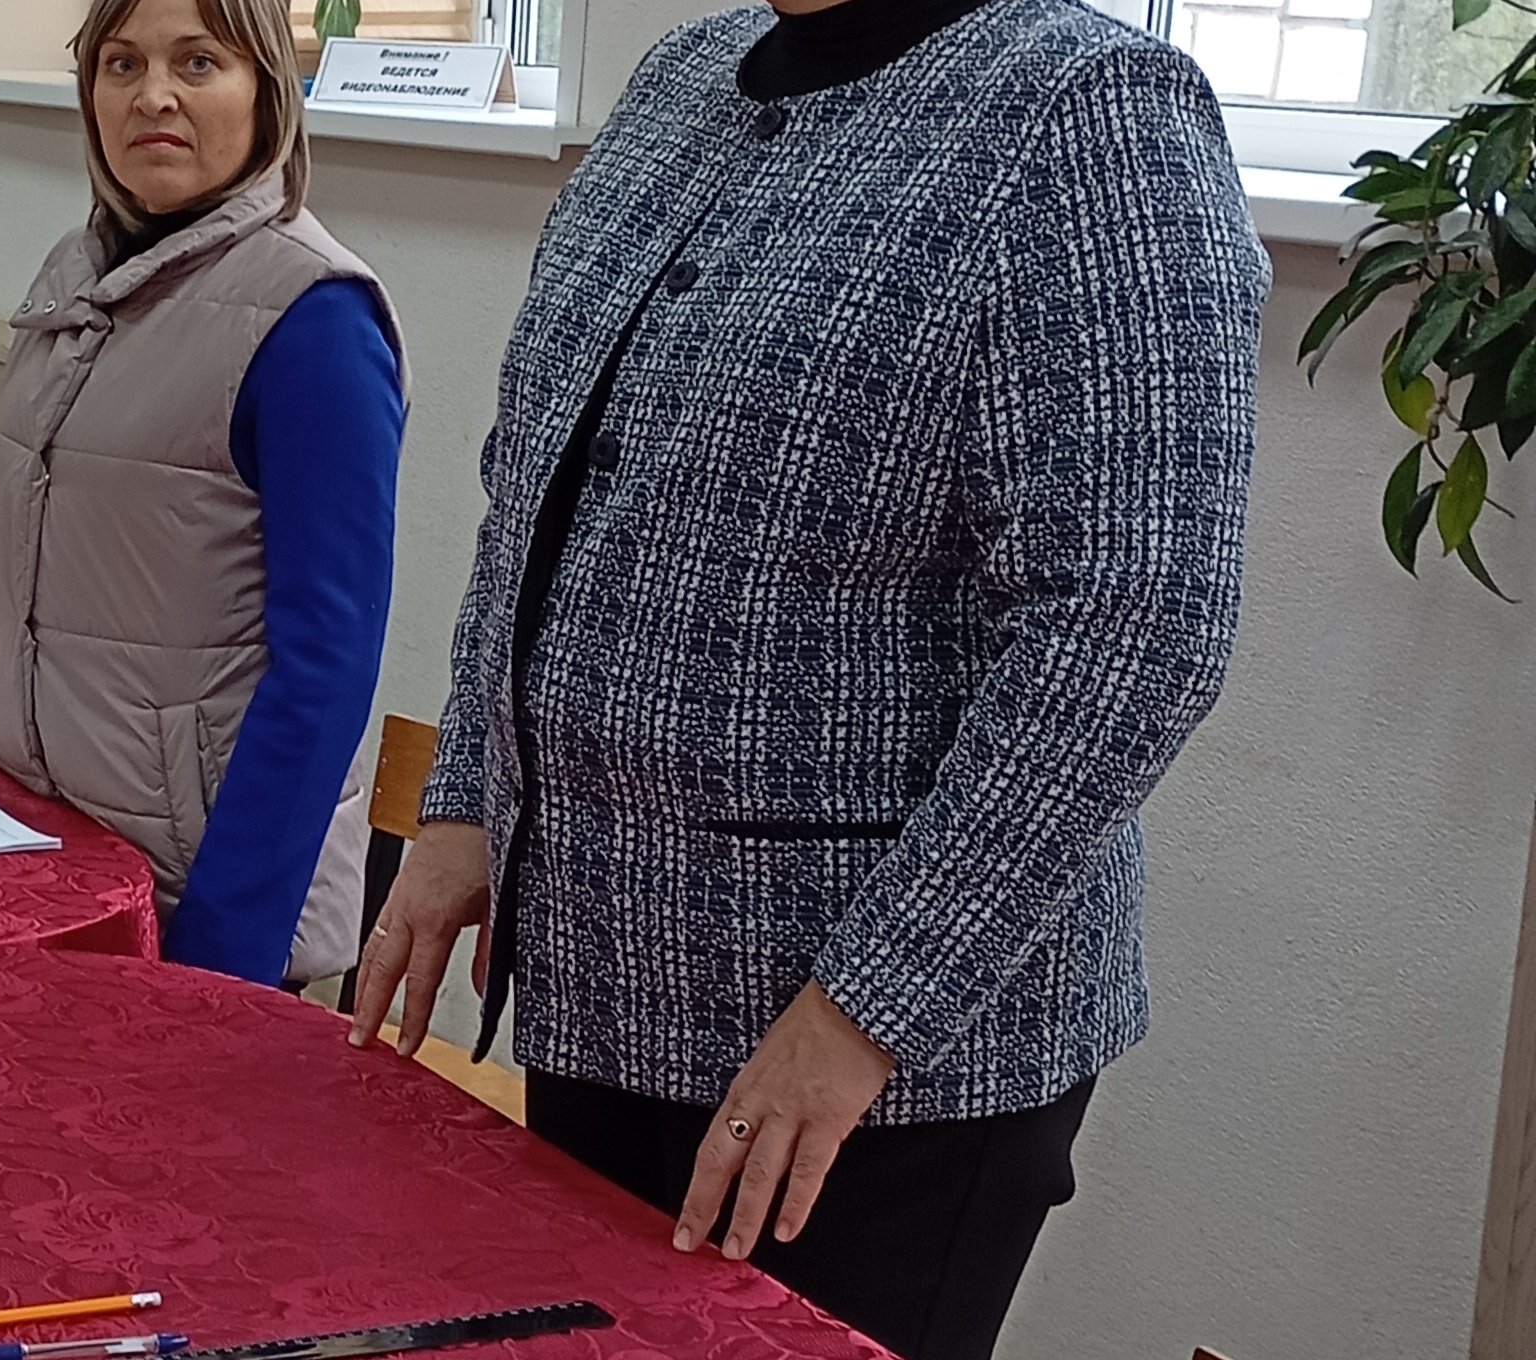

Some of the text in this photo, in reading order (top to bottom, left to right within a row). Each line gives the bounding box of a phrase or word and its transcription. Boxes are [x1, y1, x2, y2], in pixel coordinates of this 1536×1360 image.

[379, 48, 441, 61] Внимание
[380, 66, 439, 78] ВЕДЕТСЯ
[340, 81, 471, 97] ВИДЕОНАБЛЮДЕНИЕ
